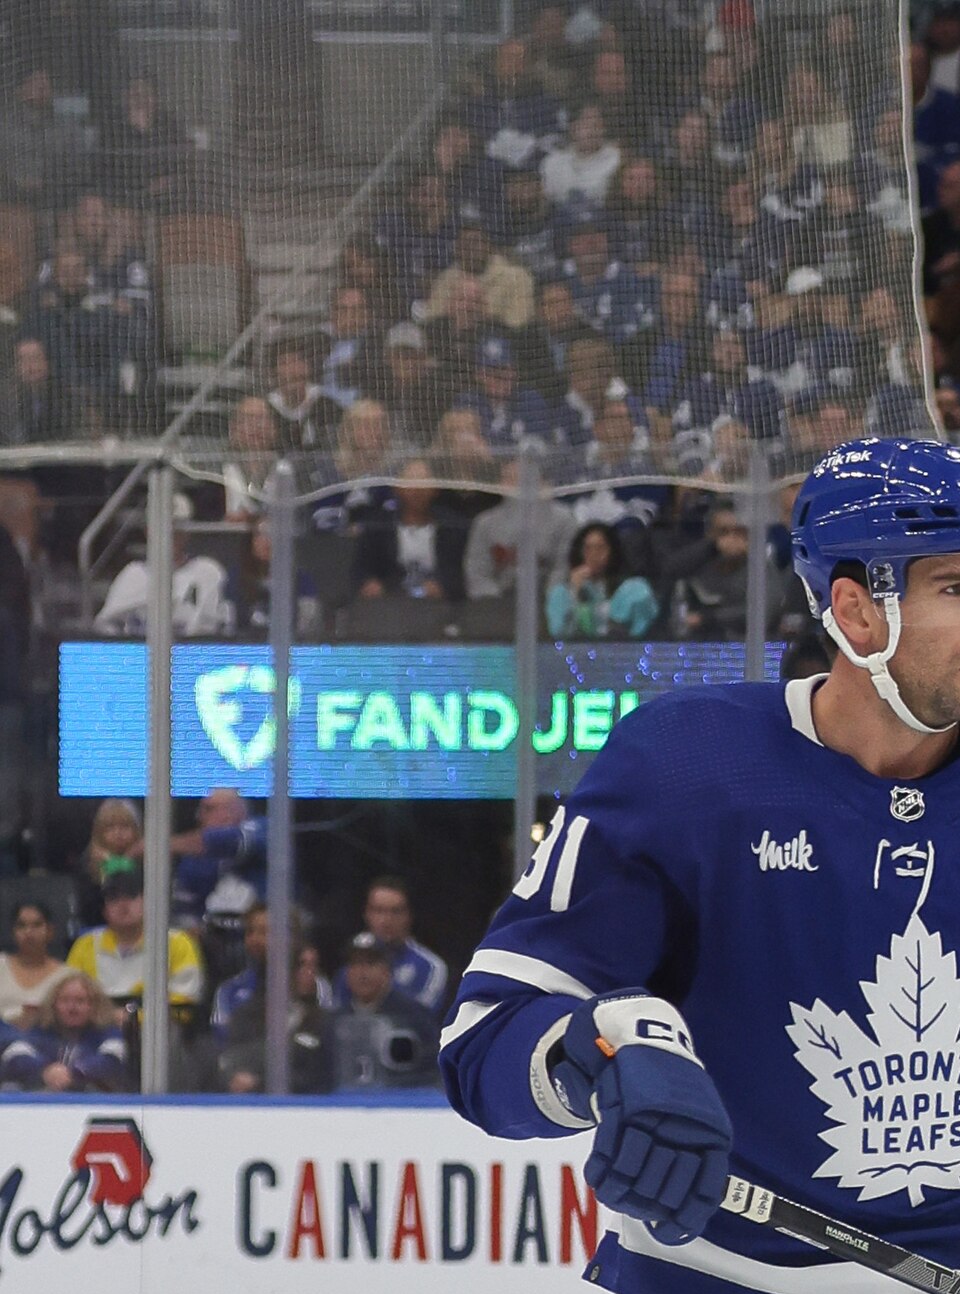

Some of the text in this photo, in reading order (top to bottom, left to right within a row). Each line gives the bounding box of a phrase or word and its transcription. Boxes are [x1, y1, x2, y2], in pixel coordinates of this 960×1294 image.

[826, 450, 873, 469] TikTok
[873, 591, 894, 599] CCM
[751, 829, 819, 872] Milk
[240, 1159, 598, 1264] CANADIAN
